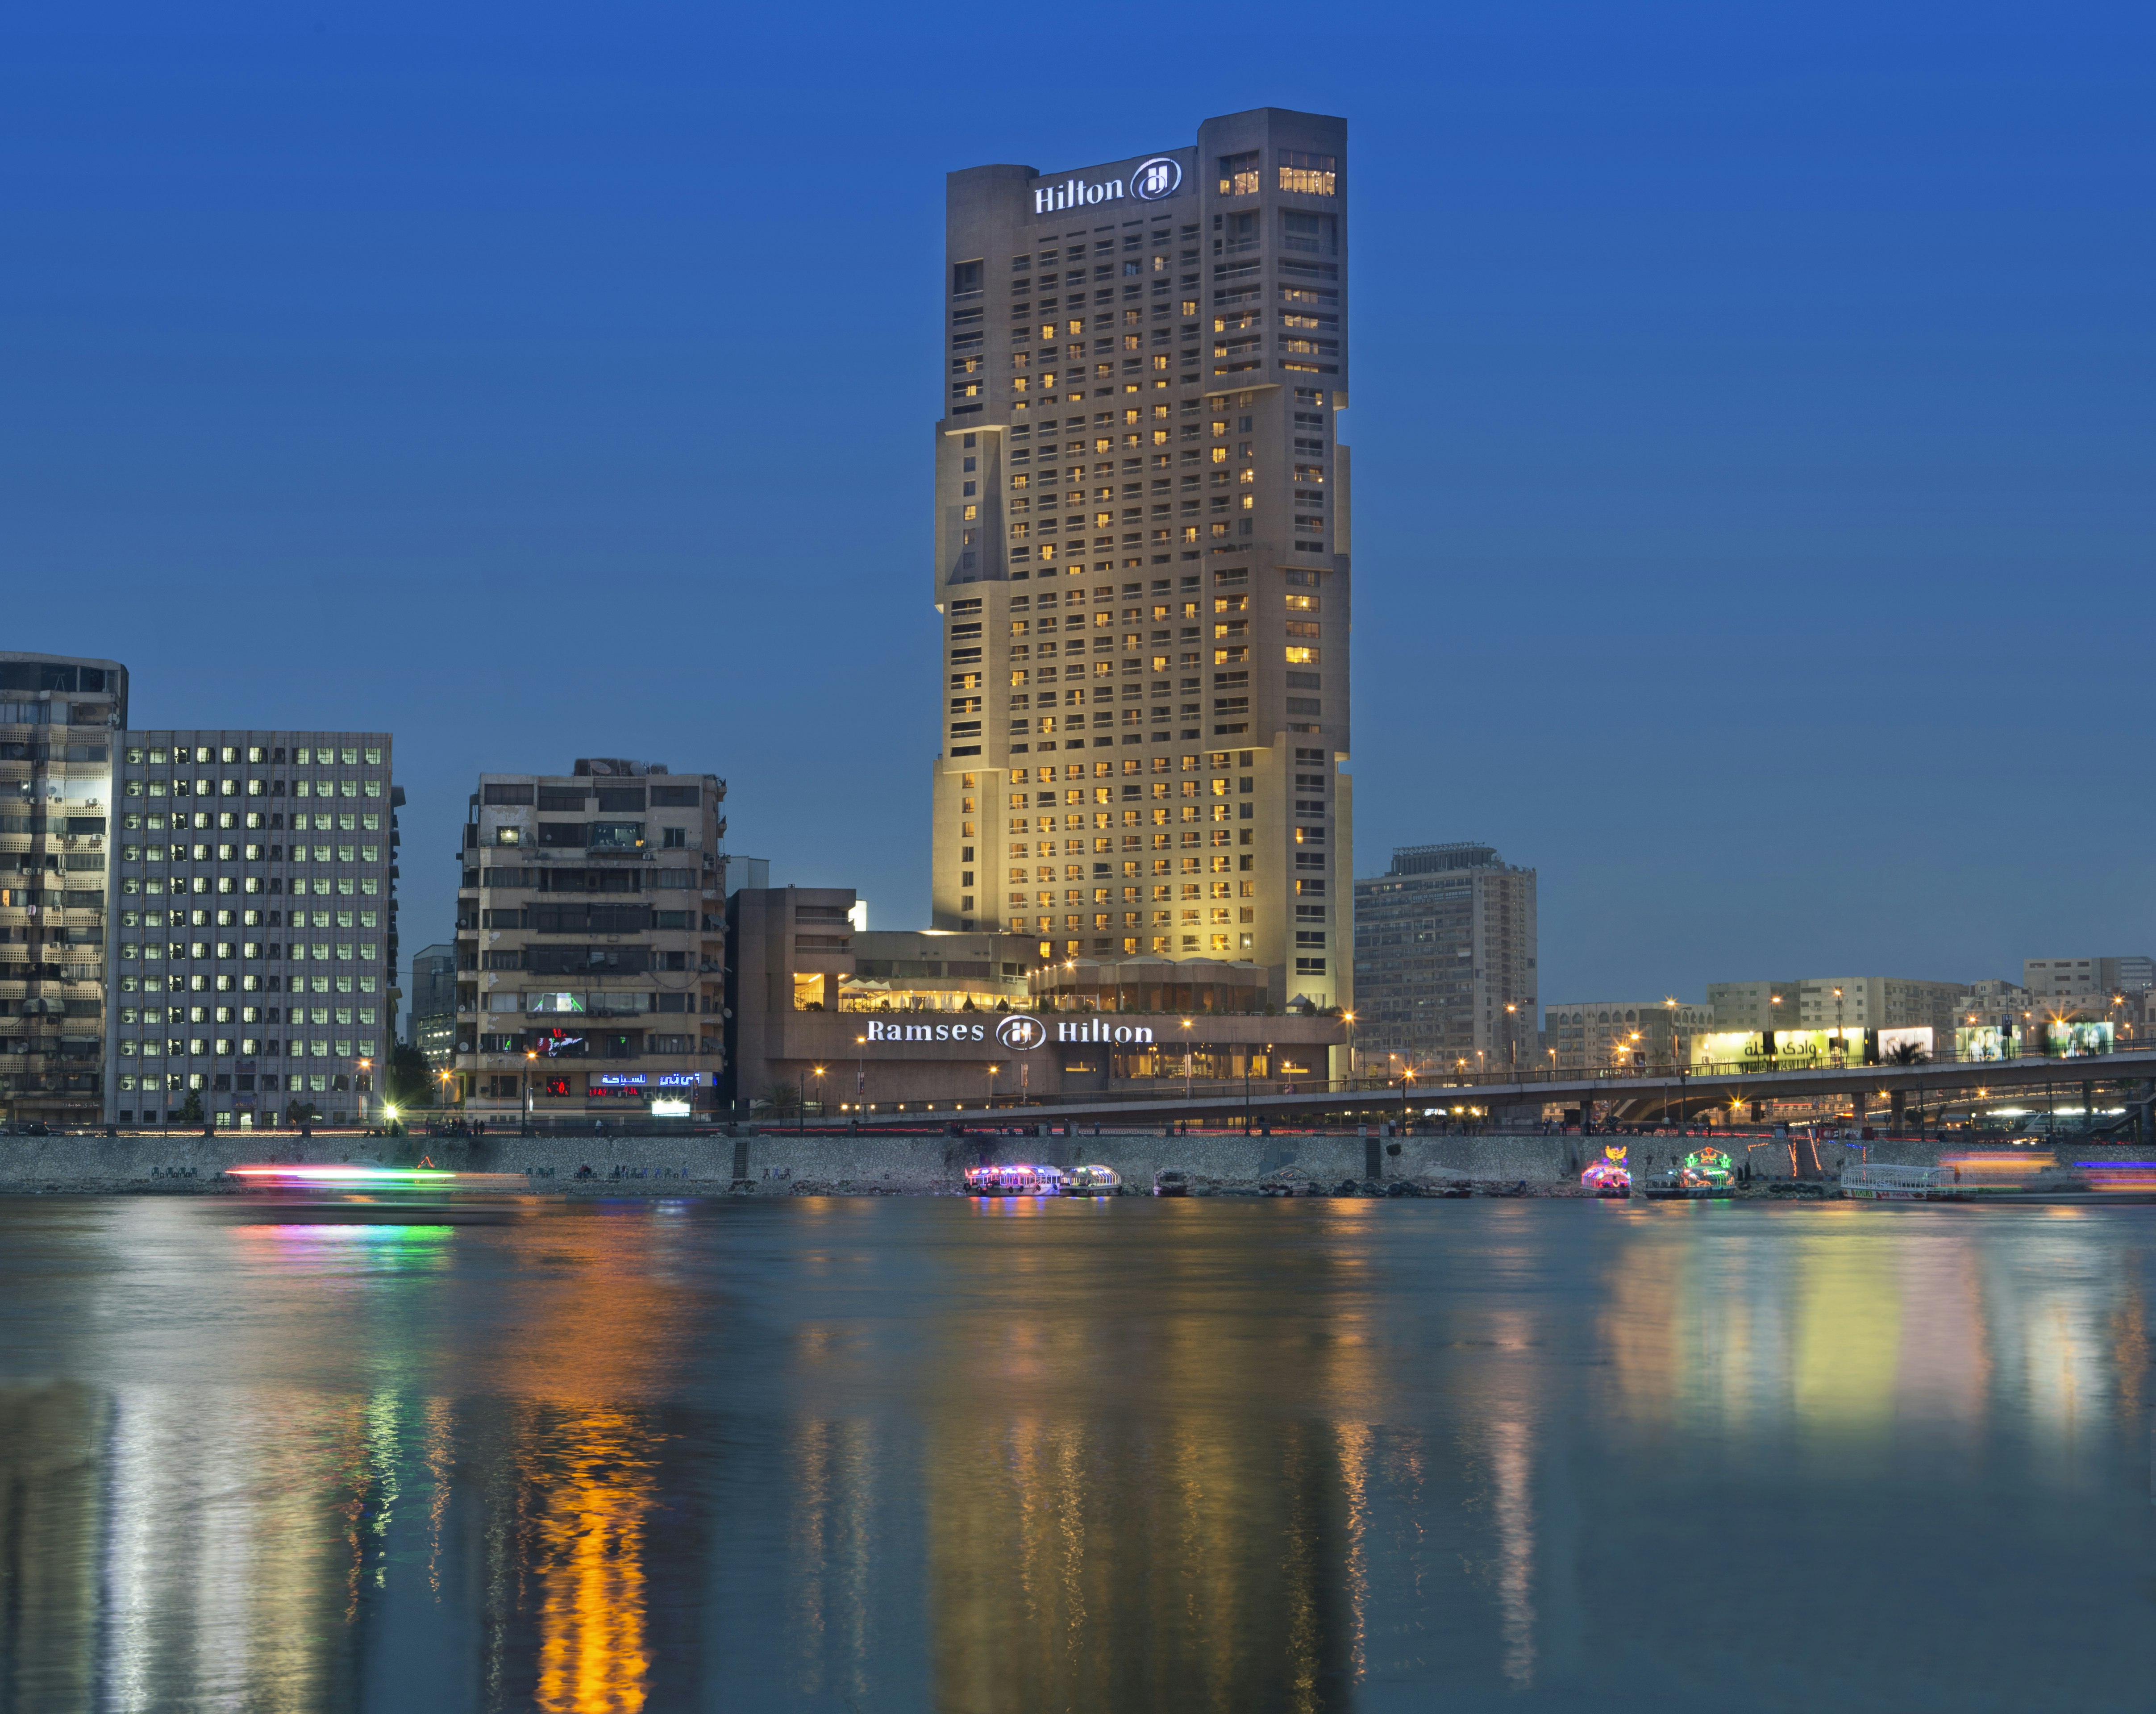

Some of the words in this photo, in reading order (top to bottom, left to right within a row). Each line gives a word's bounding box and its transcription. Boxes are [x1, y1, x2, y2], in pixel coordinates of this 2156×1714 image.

[1035, 179, 1124, 214] Hilton
[867, 1021, 984, 1041] Ramses
[1057, 1018, 1153, 1043] Hilton
[1744, 1040, 1778, 1058] لة
[602, 1074, 646, 1086] للسياحة
